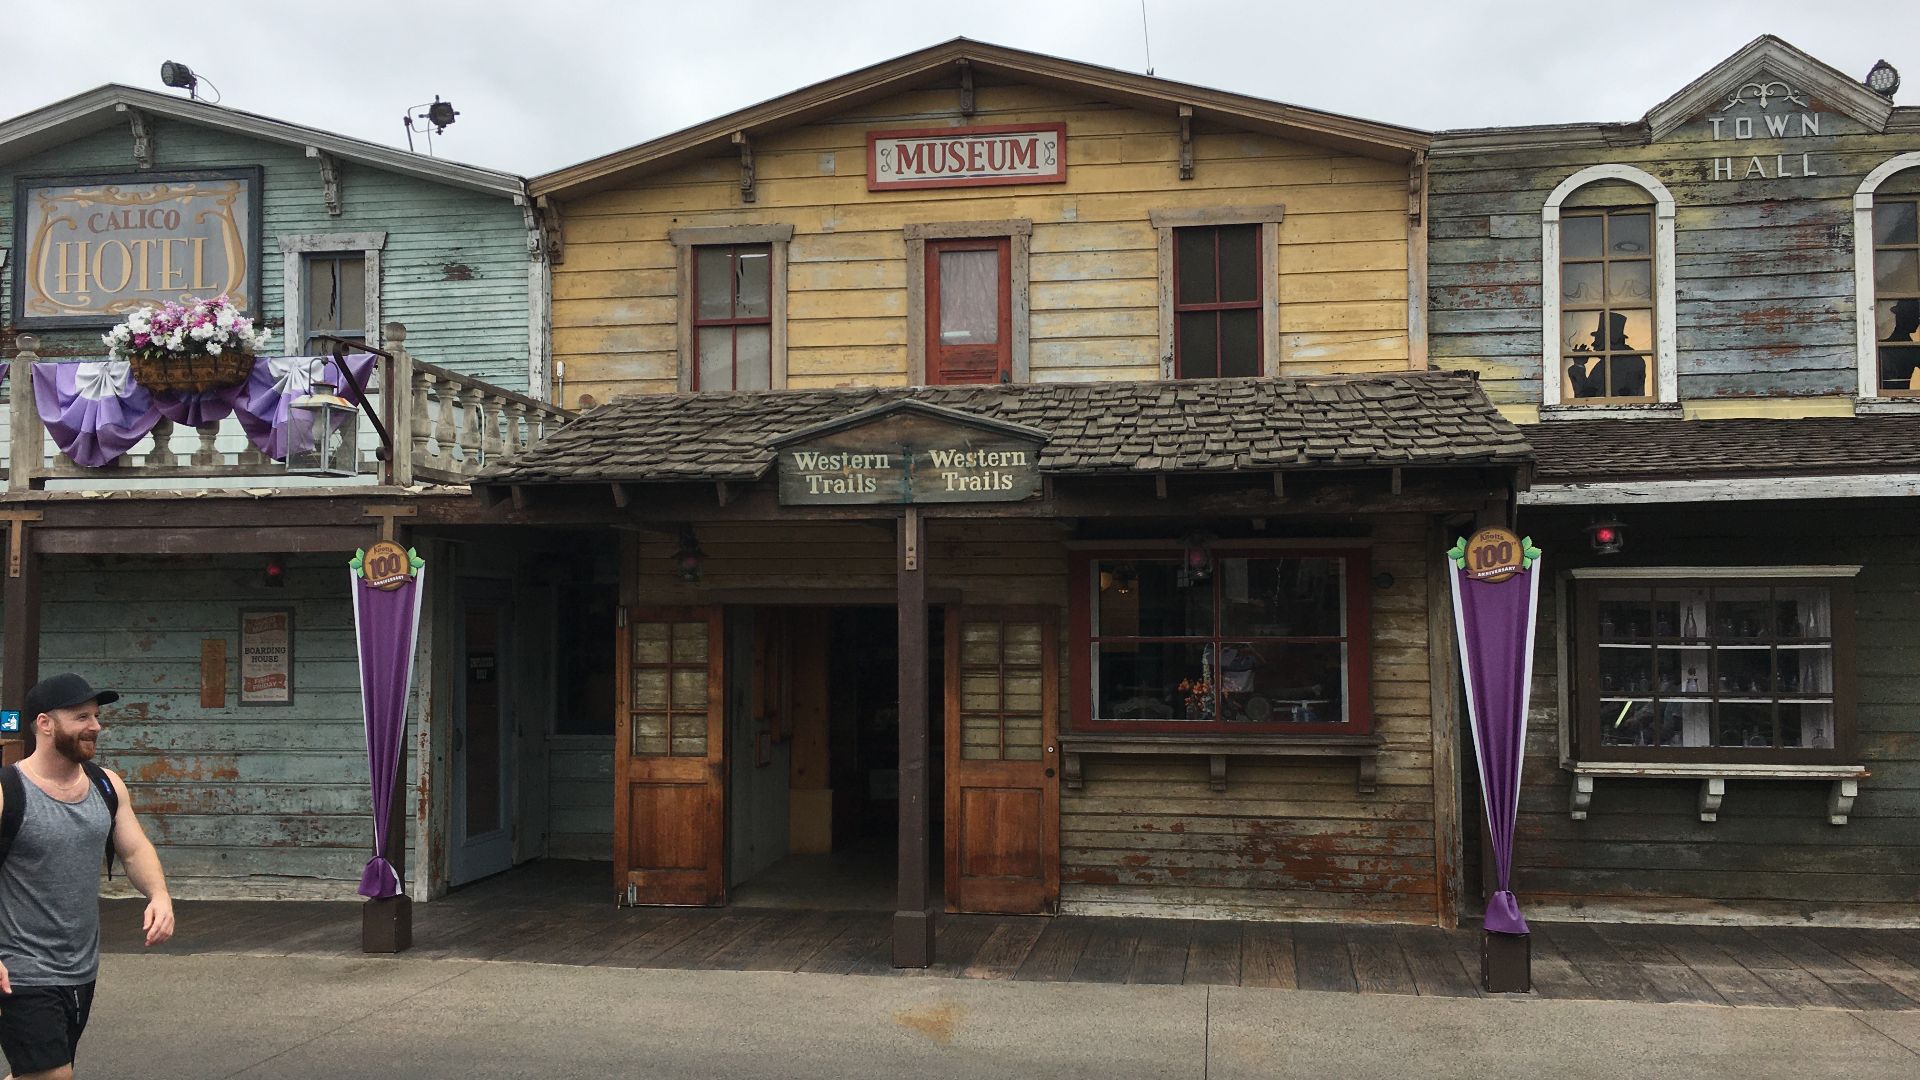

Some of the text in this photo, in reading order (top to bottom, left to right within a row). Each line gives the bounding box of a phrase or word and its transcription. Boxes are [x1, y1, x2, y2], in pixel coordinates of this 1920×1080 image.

[1708, 113, 1819, 140] TOWN
[895, 138, 1039, 174] MUSEUM
[1714, 153, 1817, 180] HALL
[88, 208, 180, 233] CALICO
[55, 237, 218, 294] HOTEL
[792, 451, 890, 471] Western
[928, 449, 1026, 468] Western
[806, 474, 877, 494] Trails
[942, 471, 1013, 491] Trails
[1473, 541, 1512, 569] 100
[368, 553, 401, 579] 100
[1478, 566, 1516, 576] ANNIVERSARY
[374, 575, 404, 586] ANNIVERSARY
[244, 646, 286, 655] BOARDING
[251, 655, 279, 663] HOUSE
